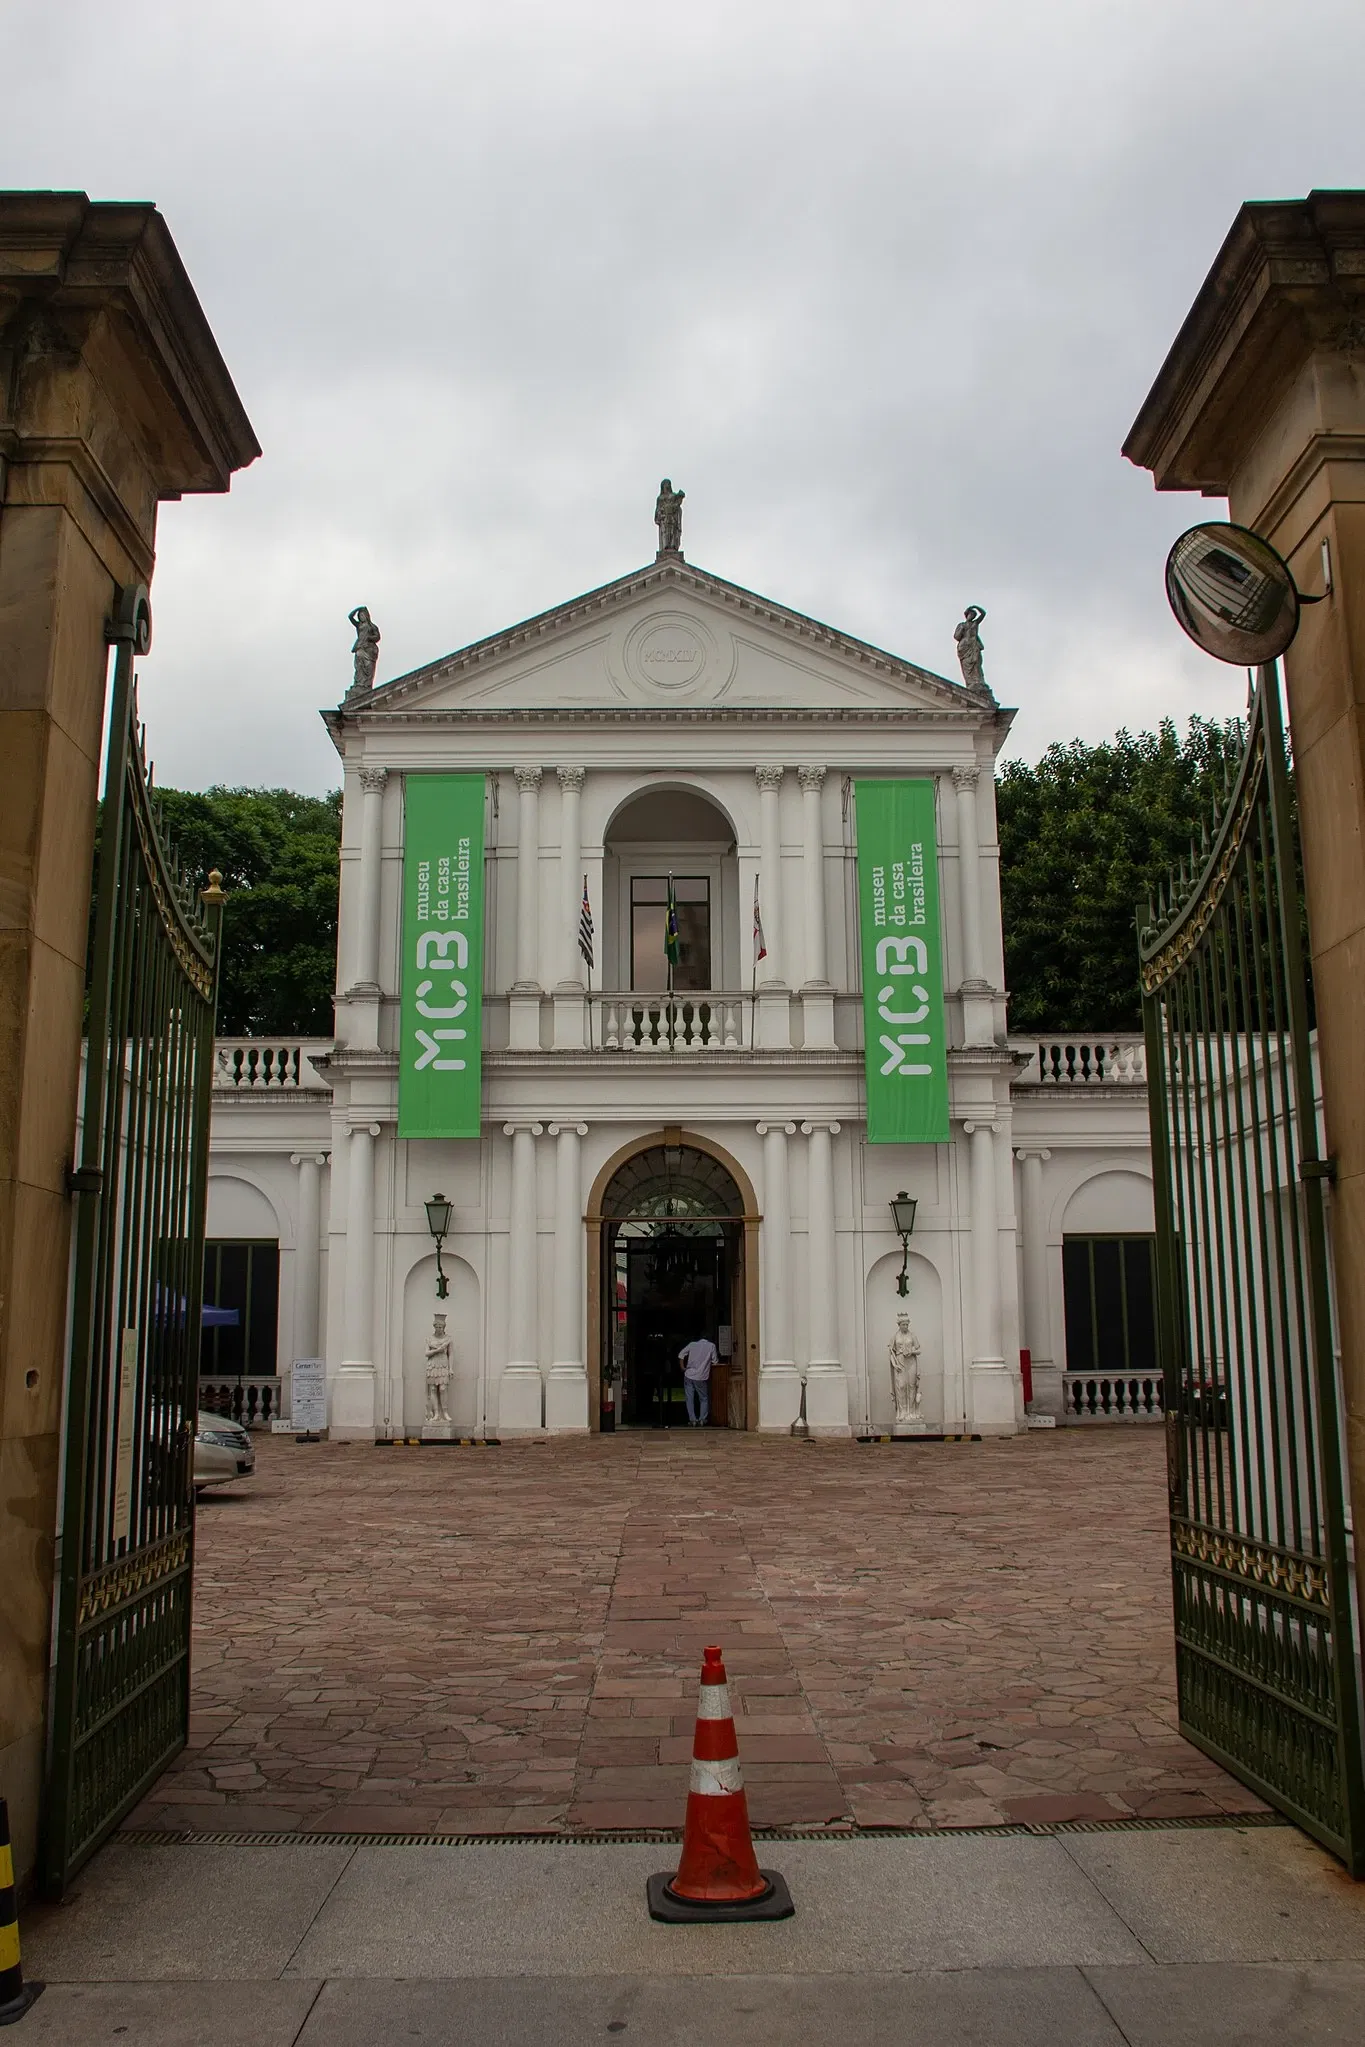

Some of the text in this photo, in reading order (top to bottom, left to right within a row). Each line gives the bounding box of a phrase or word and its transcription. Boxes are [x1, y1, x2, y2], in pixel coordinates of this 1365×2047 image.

[416, 860, 430, 921] museu
[431, 857, 450, 921] da casa
[451, 837, 470, 921] brasileira
[873, 865, 885, 927] museu
[889, 863, 905, 926] da casa
[907, 842, 925, 926] brasileira
[414, 930, 469, 1071] MCB
[876, 935, 932, 1076] MCB
